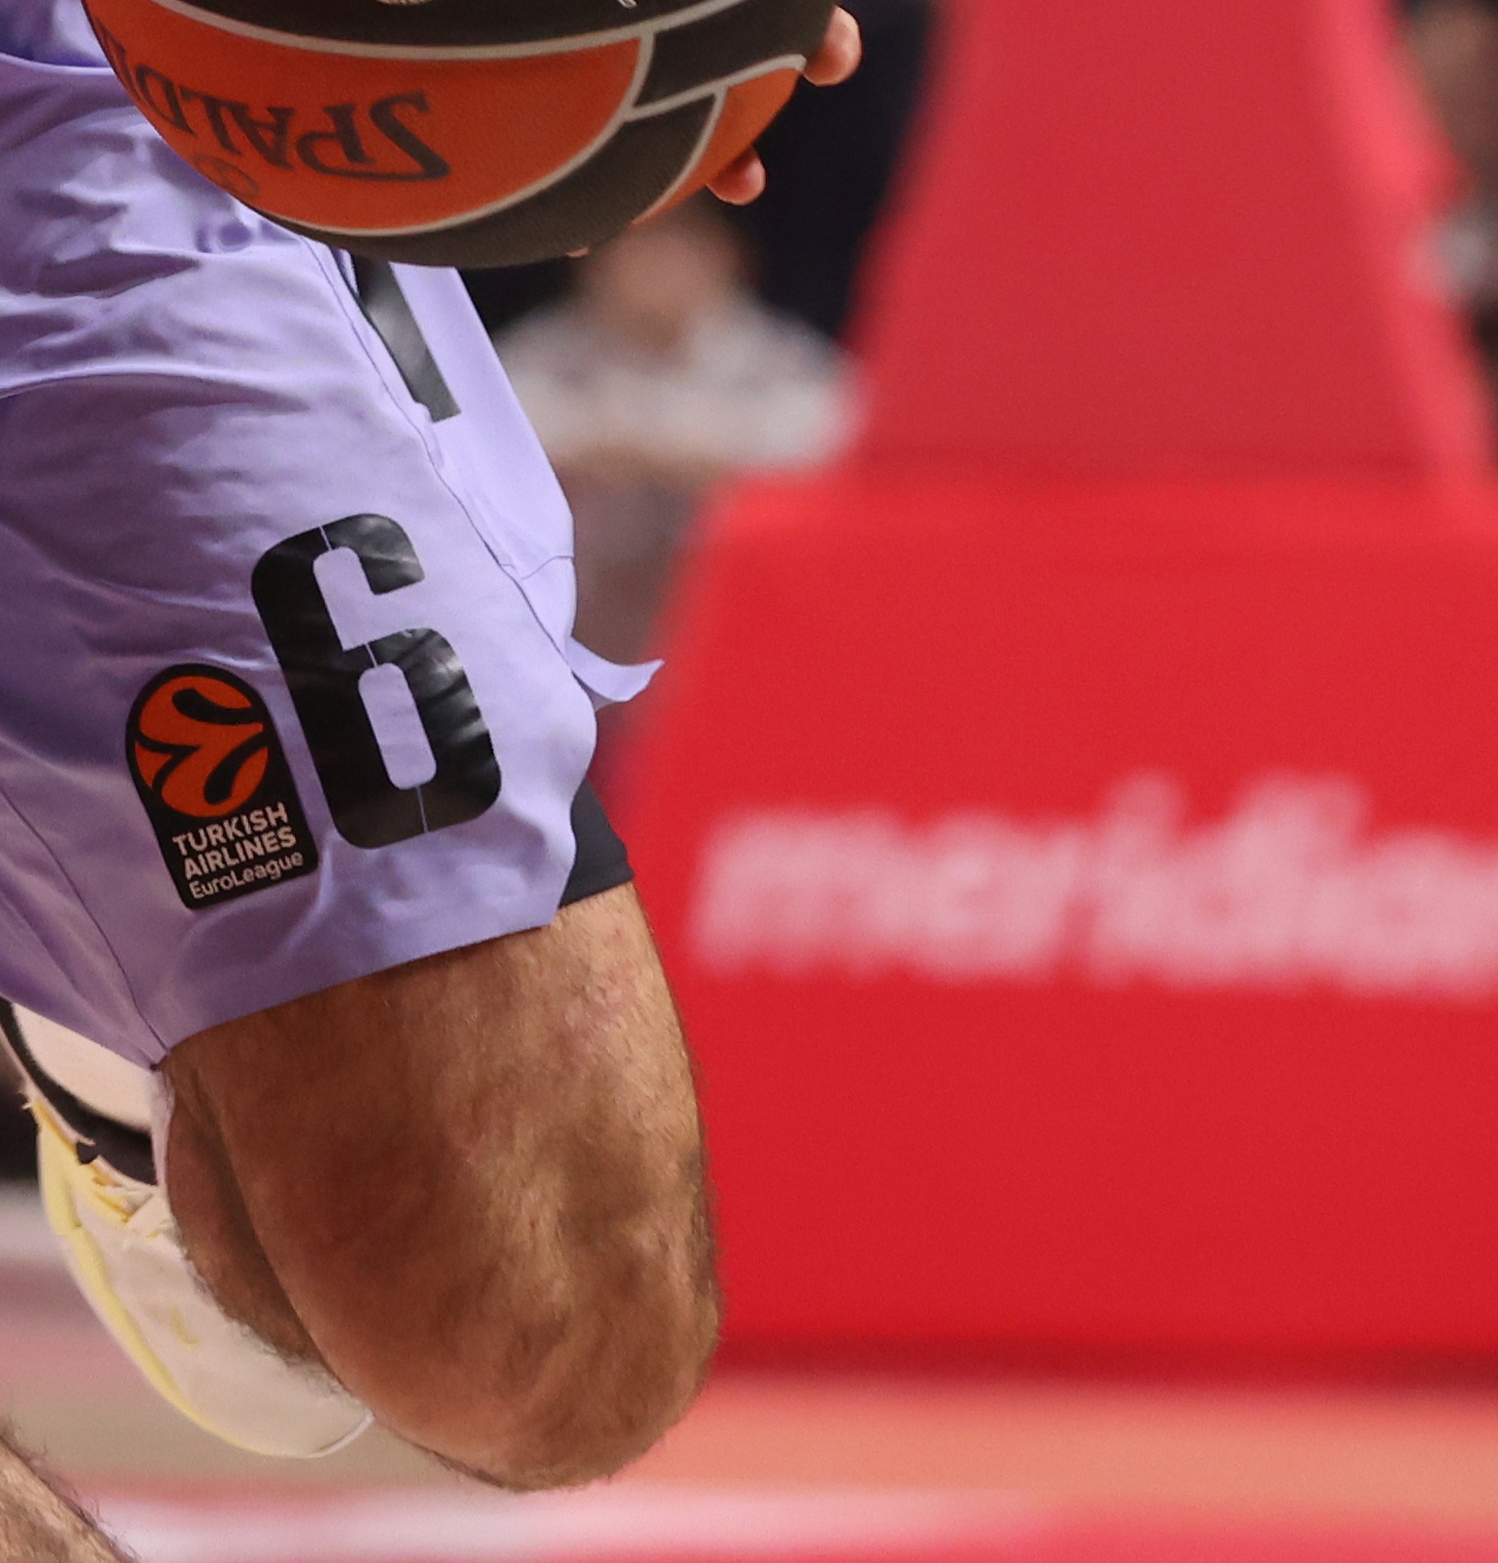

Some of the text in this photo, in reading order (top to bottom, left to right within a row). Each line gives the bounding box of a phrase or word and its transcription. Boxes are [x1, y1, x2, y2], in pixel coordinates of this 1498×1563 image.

[251, 513, 502, 849] 6
[172, 802, 289, 856] TURKISH
[184, 826, 297, 880] AIRLINES
[189, 852, 304, 899] EuroLeague
